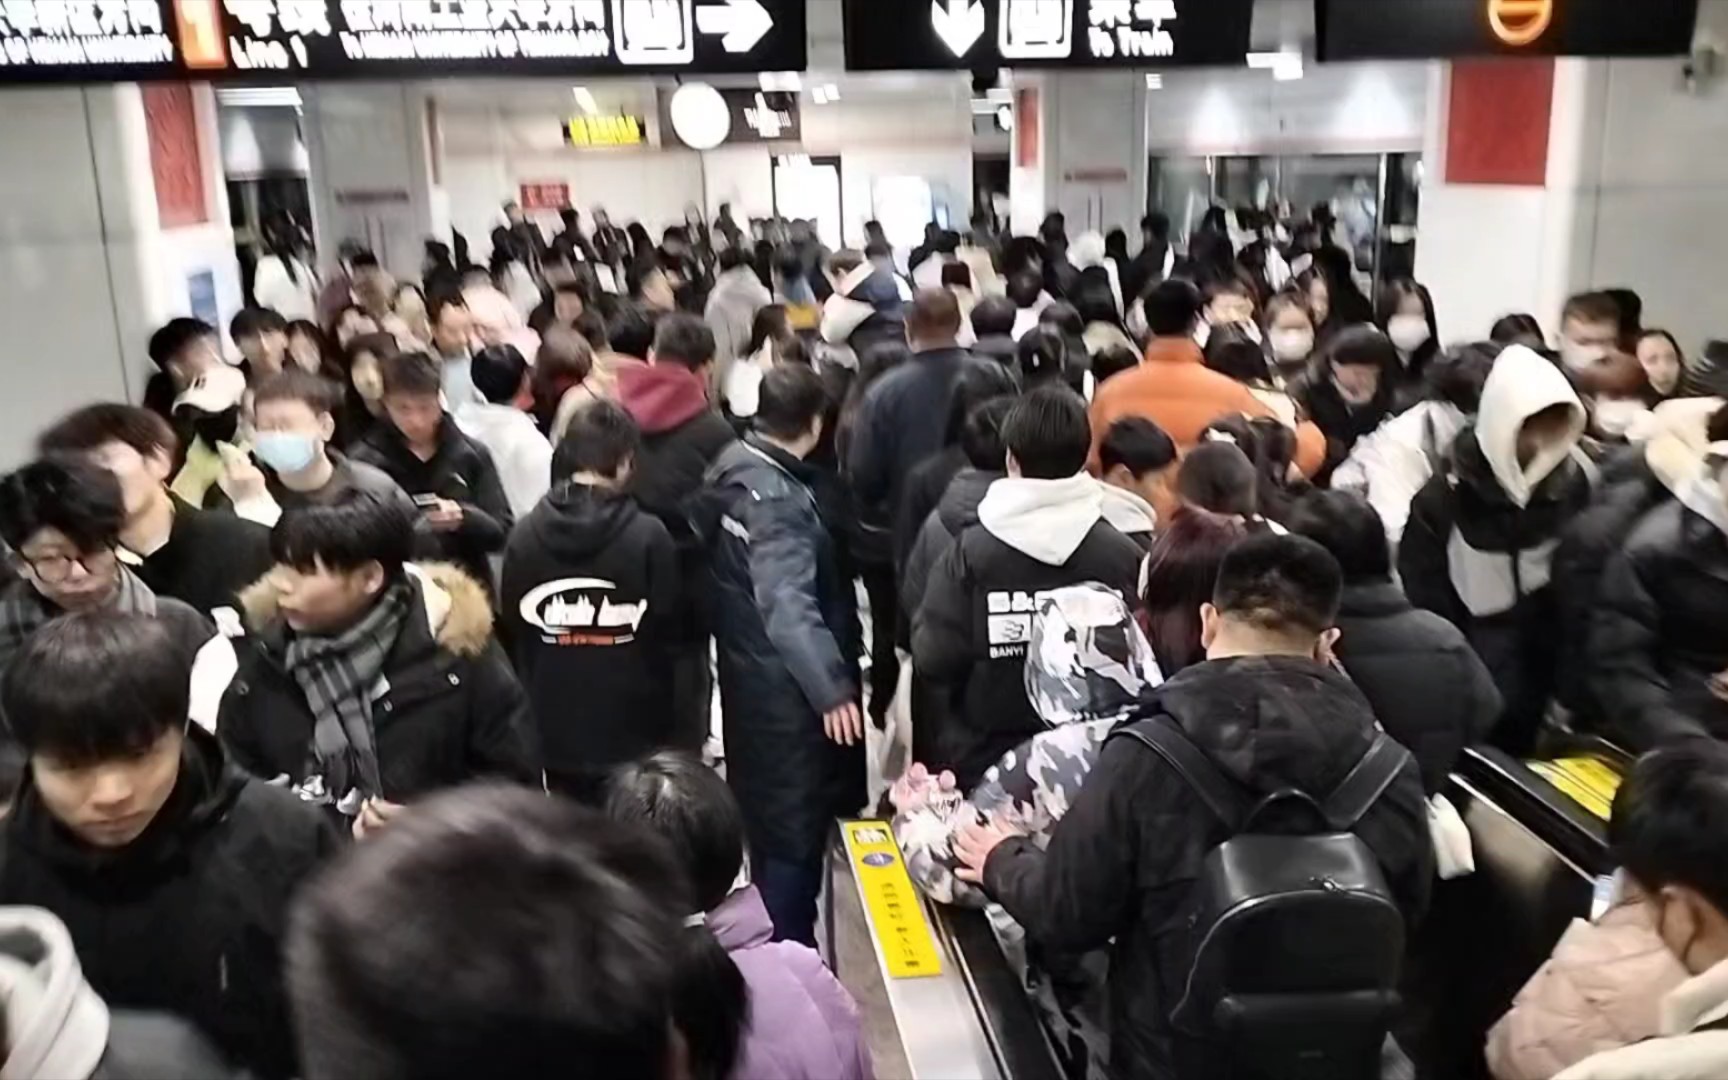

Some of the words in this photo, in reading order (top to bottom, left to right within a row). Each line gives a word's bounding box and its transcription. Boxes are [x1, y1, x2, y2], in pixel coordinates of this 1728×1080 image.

[229, 35, 289, 68] Line
[290, 34, 308, 68] 1
[1117, 26, 1175, 57] Train
